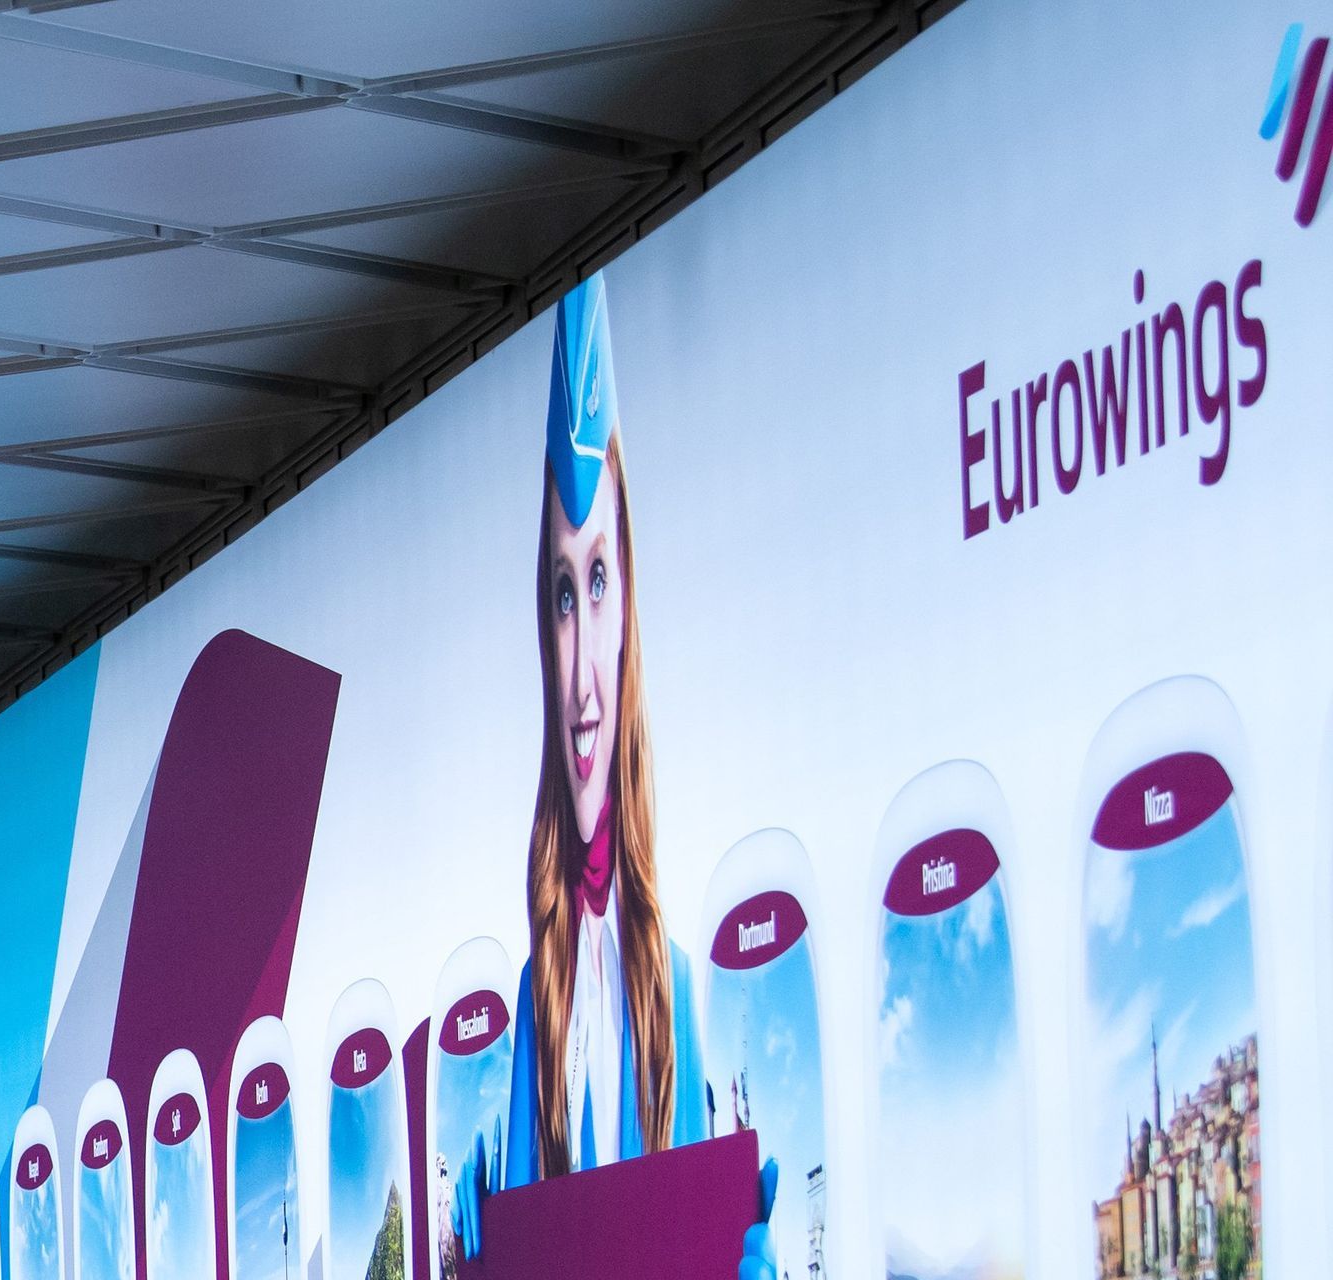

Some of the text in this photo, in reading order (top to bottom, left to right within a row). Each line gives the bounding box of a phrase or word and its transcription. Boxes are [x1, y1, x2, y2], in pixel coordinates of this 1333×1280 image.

[958, 259, 1267, 541] Eurowings
[1144, 786, 1173, 826] Nizza
[922, 856, 955, 895] Pristina
[738, 910, 775, 952] Dortmund
